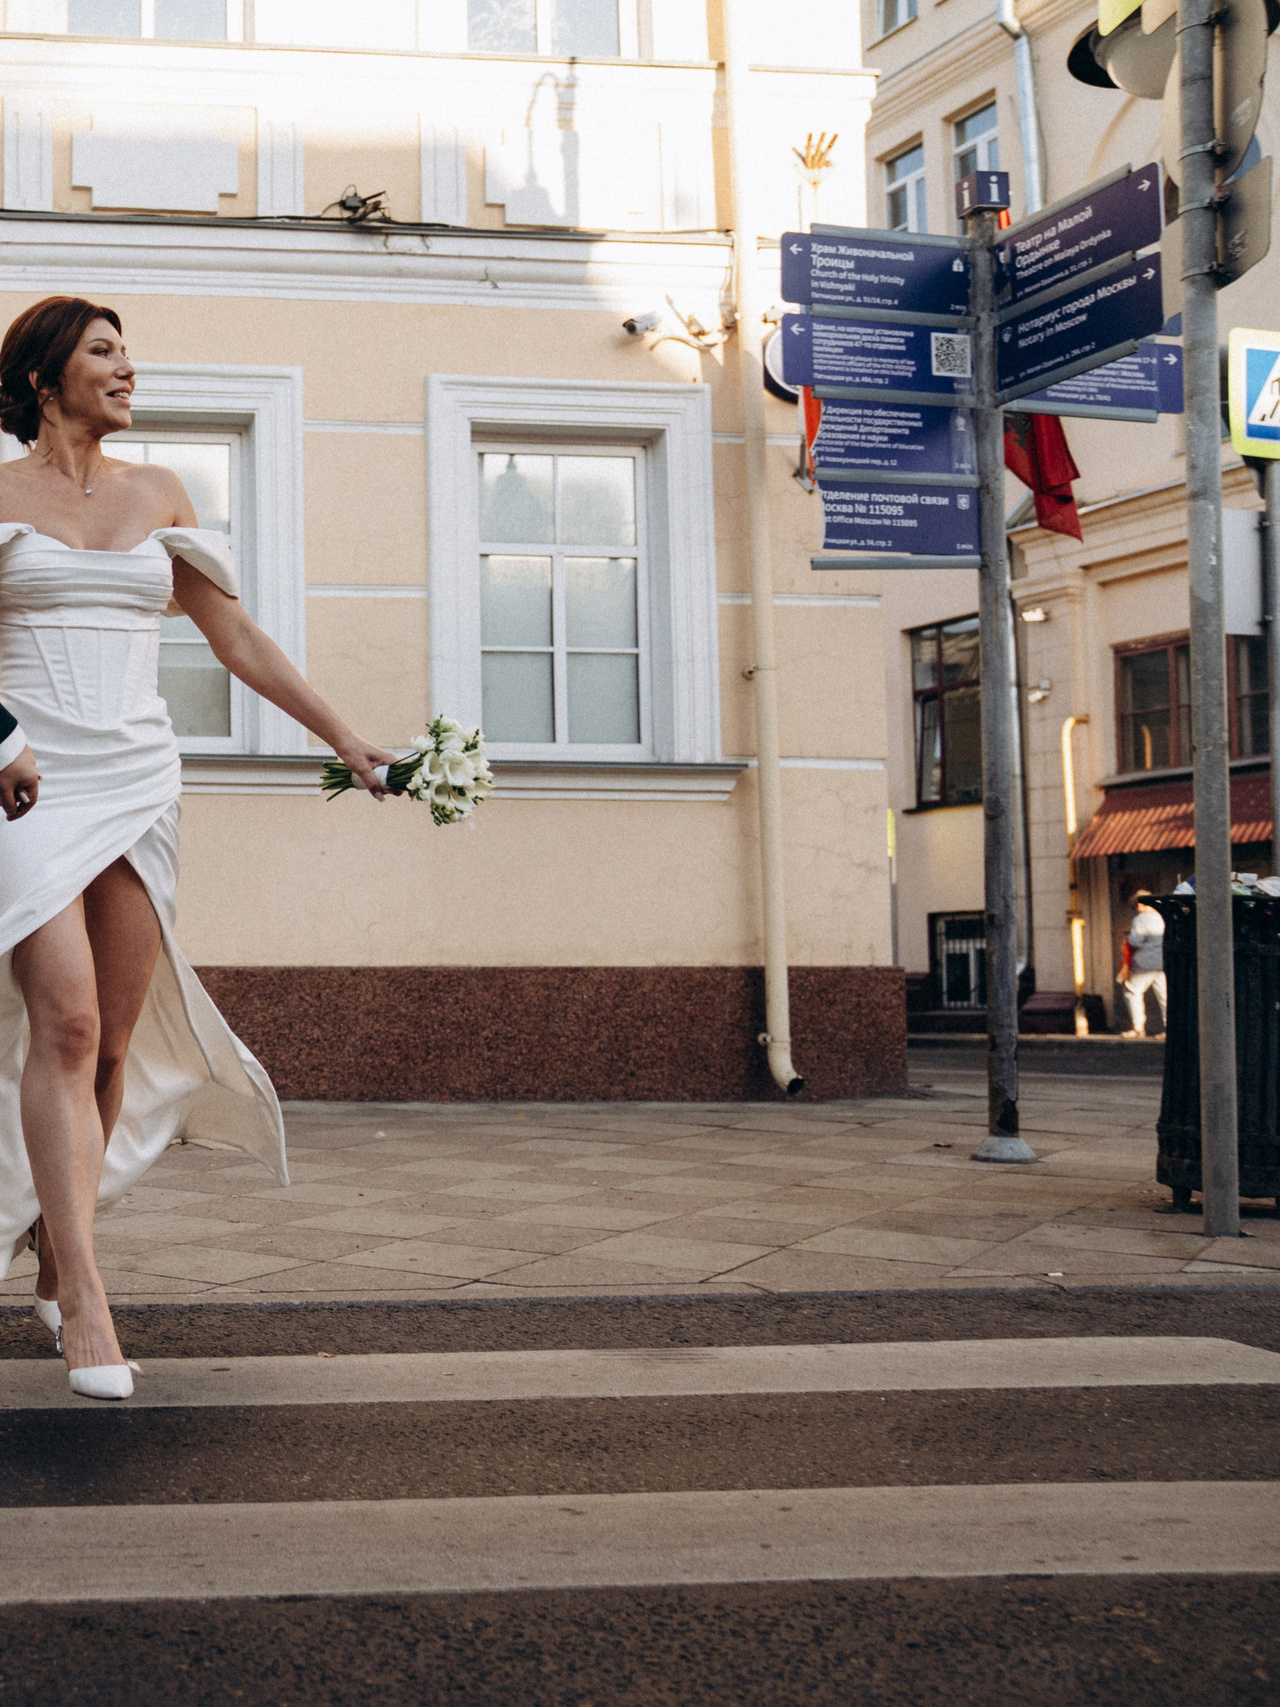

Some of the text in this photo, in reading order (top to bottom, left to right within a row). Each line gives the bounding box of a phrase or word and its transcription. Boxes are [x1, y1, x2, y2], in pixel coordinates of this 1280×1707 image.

[1015, 205, 1093, 254] Театр на Малой
[1079, 229, 1112, 250] Ordynka
[810, 243, 915, 262] Храм Живоначальной
[810, 254, 855, 269] Троицы
[1015, 239, 1061, 268] Ордынке
[811, 270, 905, 286] Church of the Holy Trinity
[820, 281, 856, 293] Vishnyaki
[1018, 275, 1137, 335] Нотариус города Москвы
[1018, 313, 1088, 349] Notary in Moscow
[820, 489, 949, 506] тделение почтовой связи
[855, 503, 866, 514] №
[869, 505, 904, 516] 115095
[832, 515, 854, 524] Office
[854, 517, 882, 526] Moscow
[882, 518, 891, 526] №
[892, 519, 917, 527] 115095
